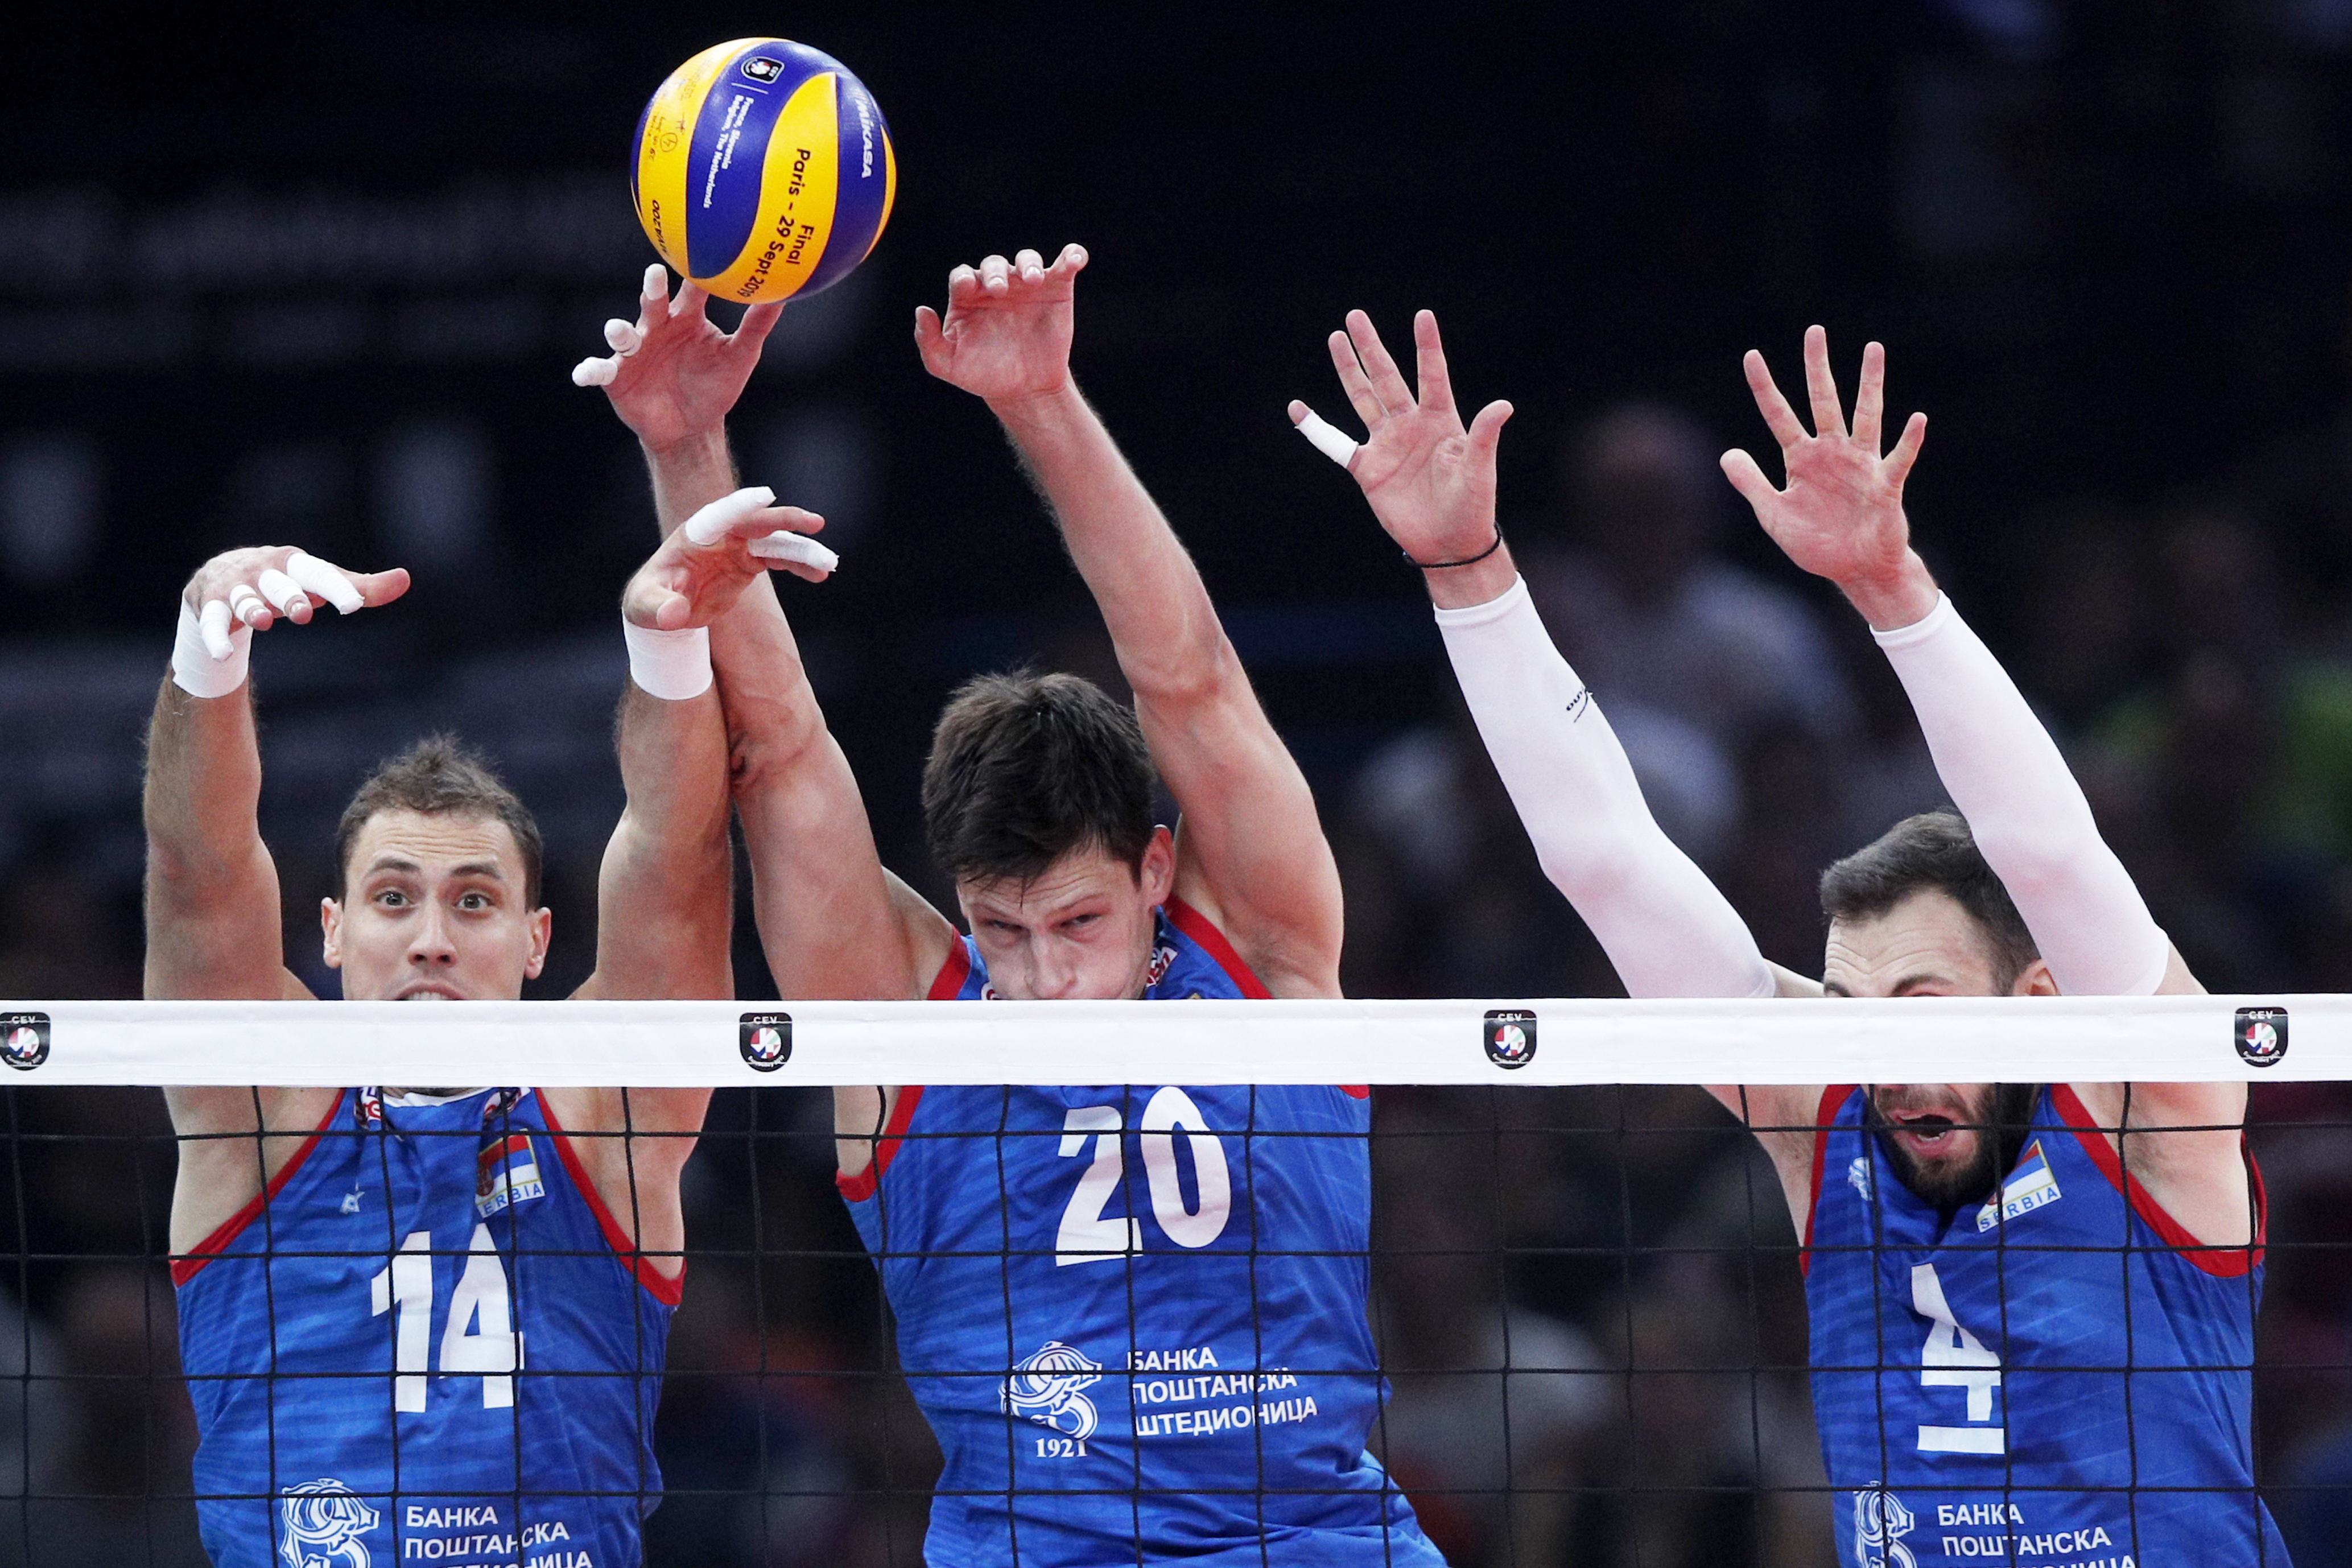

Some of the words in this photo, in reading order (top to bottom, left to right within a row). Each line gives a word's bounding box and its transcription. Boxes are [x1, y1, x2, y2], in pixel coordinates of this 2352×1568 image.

[721, 94, 744, 131] Belgium,
[733, 96, 754, 129] France,
[716, 133, 729, 151] The
[721, 129, 741, 170] Slovenia
[703, 151, 723, 209] Netherlands
[789, 148, 811, 196] Paris
[777, 215, 795, 238] 29
[754, 241, 785, 275] Sept
[786, 225, 815, 265] Final
[737, 276, 765, 298] 2019
[11, 1016, 36, 1025] CEV
[753, 1016, 778, 1025] CEV
[1497, 1013, 1522, 1022] CEV
[2248, 1010, 2273, 1020] CEV
[1055, 1086, 1231, 1268] 20
[484, 1182, 543, 1215] ERBIA
[371, 1223, 525, 1413] 14
[1127, 1346, 1219, 1371] БАНКА
[1911, 1262, 2002, 1422] 4
[1133, 1367, 1298, 1405] ПОШТАНСКА
[1135, 1396, 1318, 1436] ШТЕДИОНИЦА
[1035, 1438, 1088, 1458] 1921
[406, 1505, 498, 1528] БАНКА
[1937, 1503, 2025, 1526] БАНКА
[405, 1521, 570, 1559] ПОШТАНСКА
